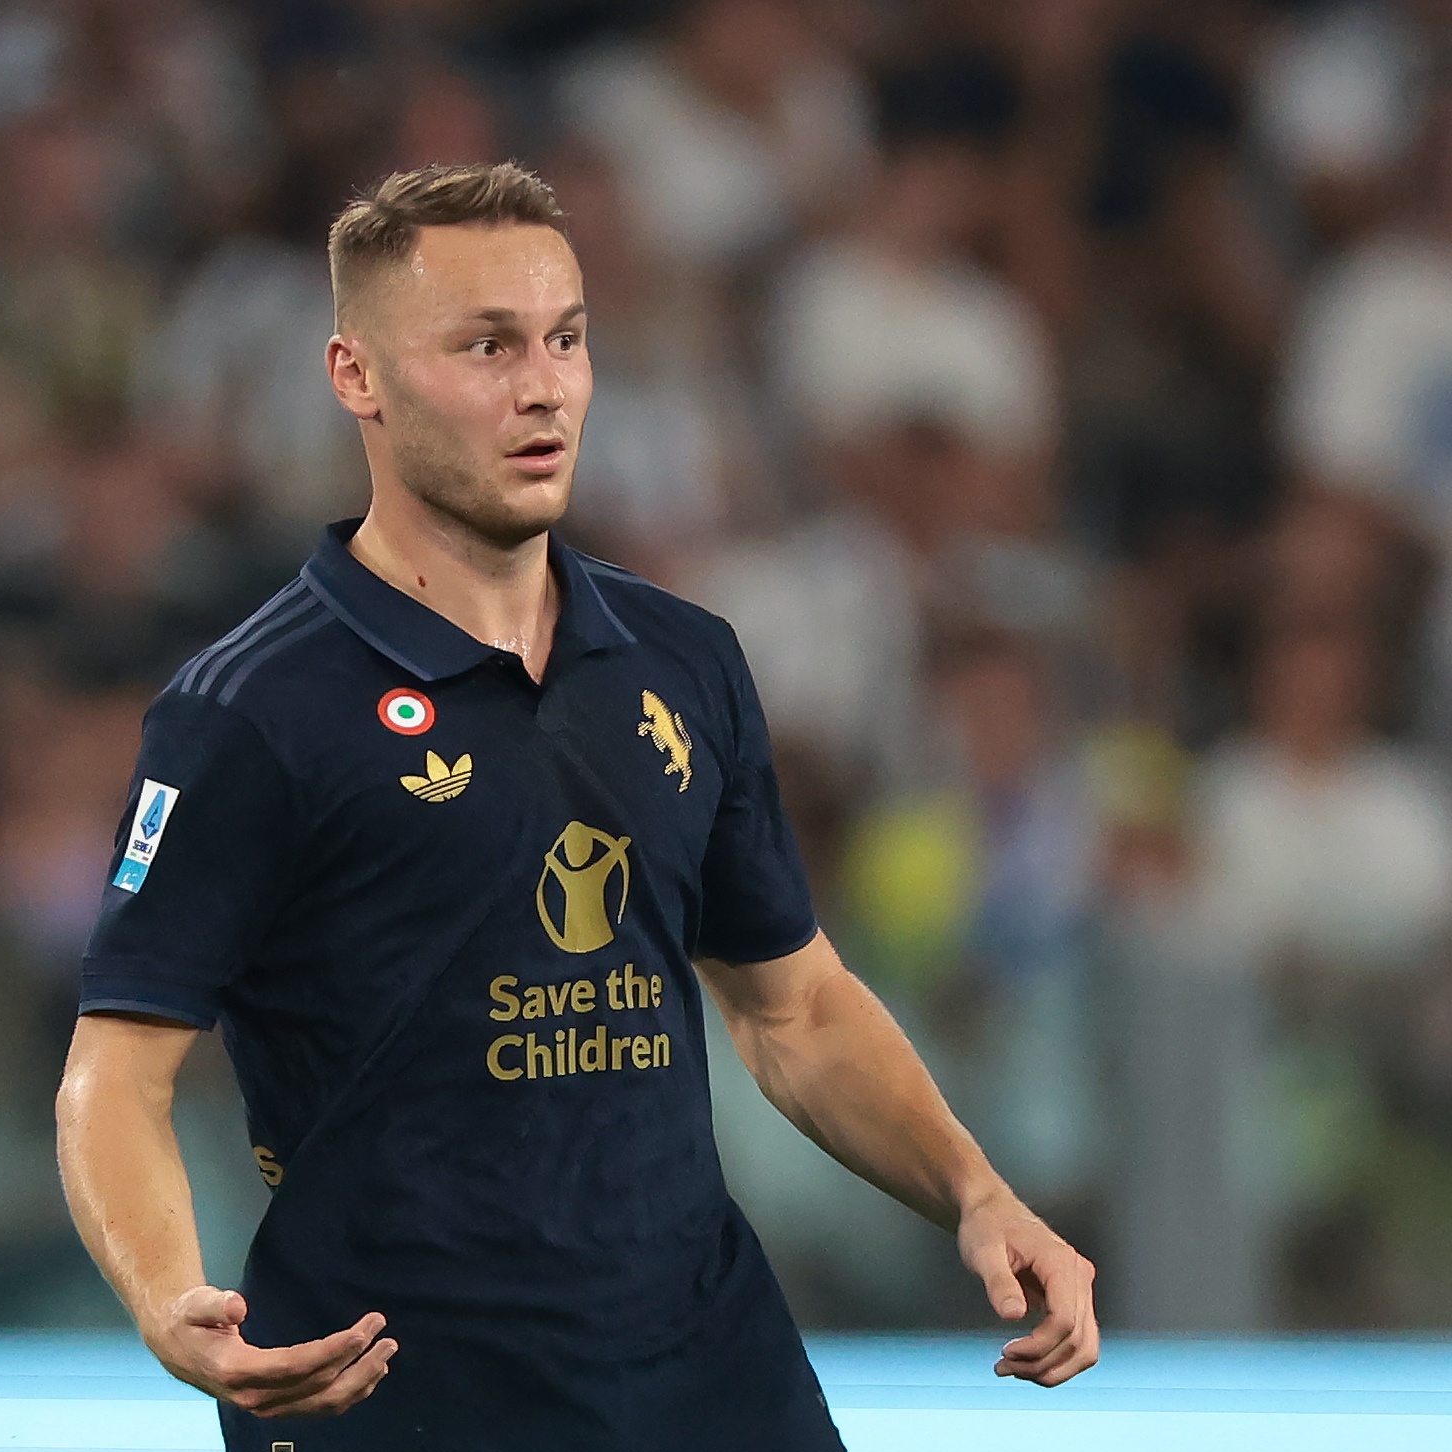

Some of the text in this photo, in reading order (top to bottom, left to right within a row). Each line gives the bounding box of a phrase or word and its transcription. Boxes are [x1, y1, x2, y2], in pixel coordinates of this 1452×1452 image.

[488, 962, 663, 1022] Save the
[485, 1024, 671, 1081] Children
